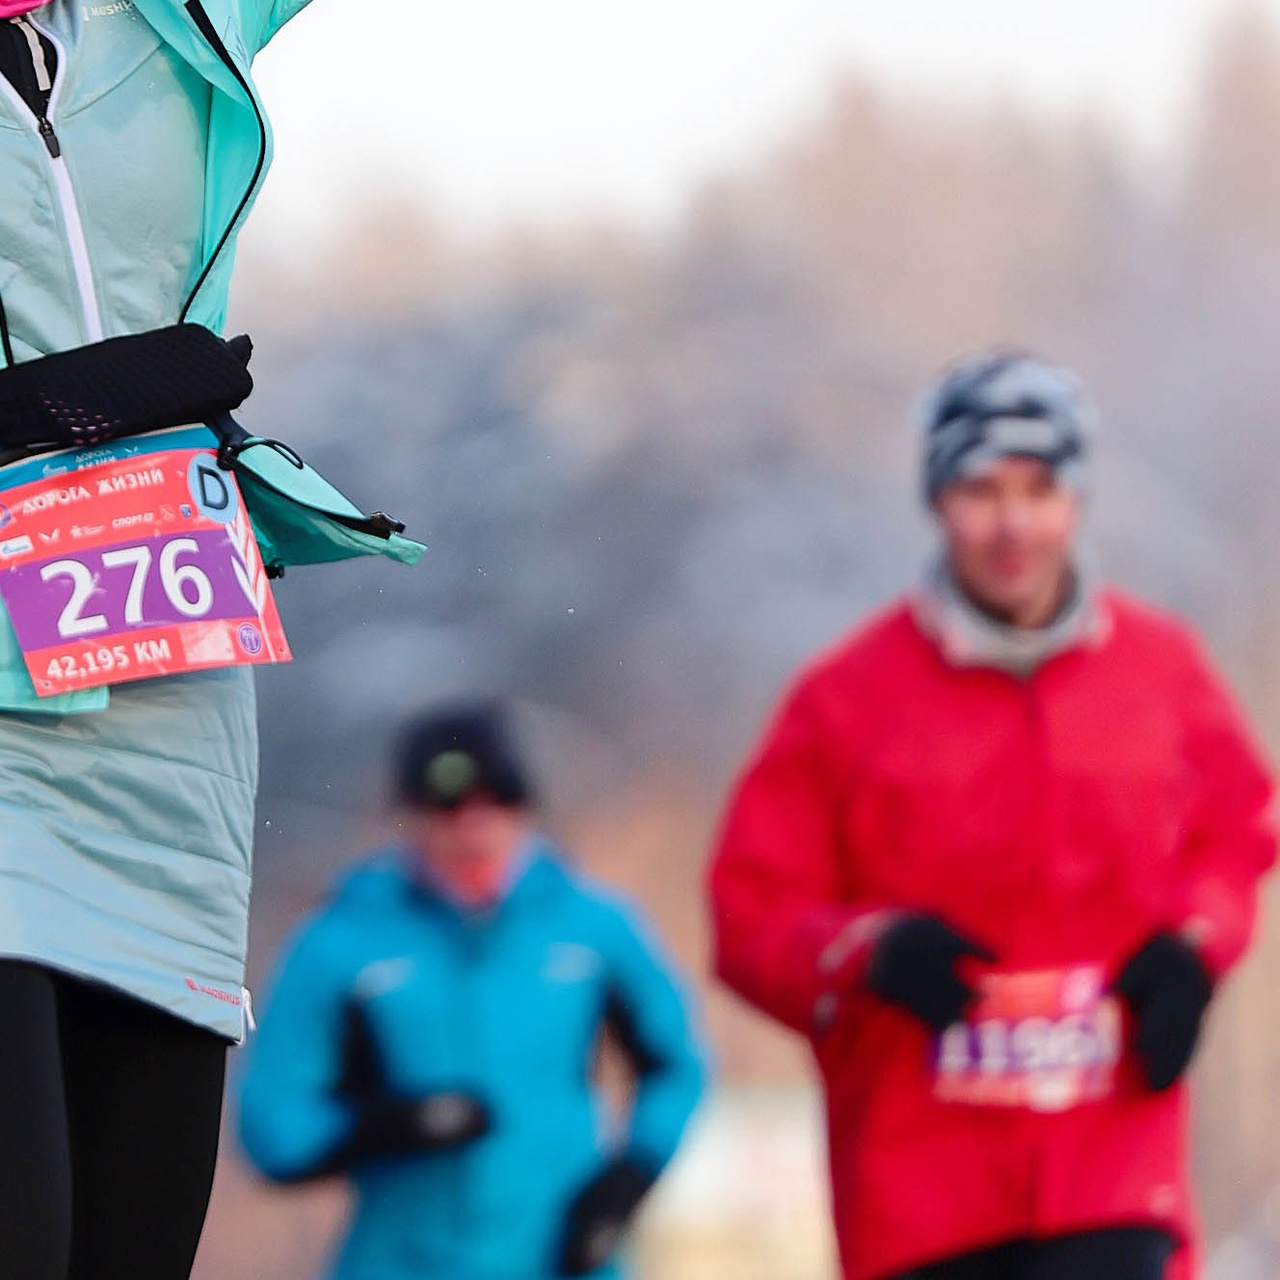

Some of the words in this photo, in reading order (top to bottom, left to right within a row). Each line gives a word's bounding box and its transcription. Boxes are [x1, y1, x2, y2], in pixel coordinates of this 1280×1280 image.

[23, 486, 91, 514] ДОРОГА
[98, 469, 165, 495] ЖИЗНИ
[198, 464, 229, 510] D
[39, 538, 214, 638] 276
[46, 644, 130, 679] 42,195
